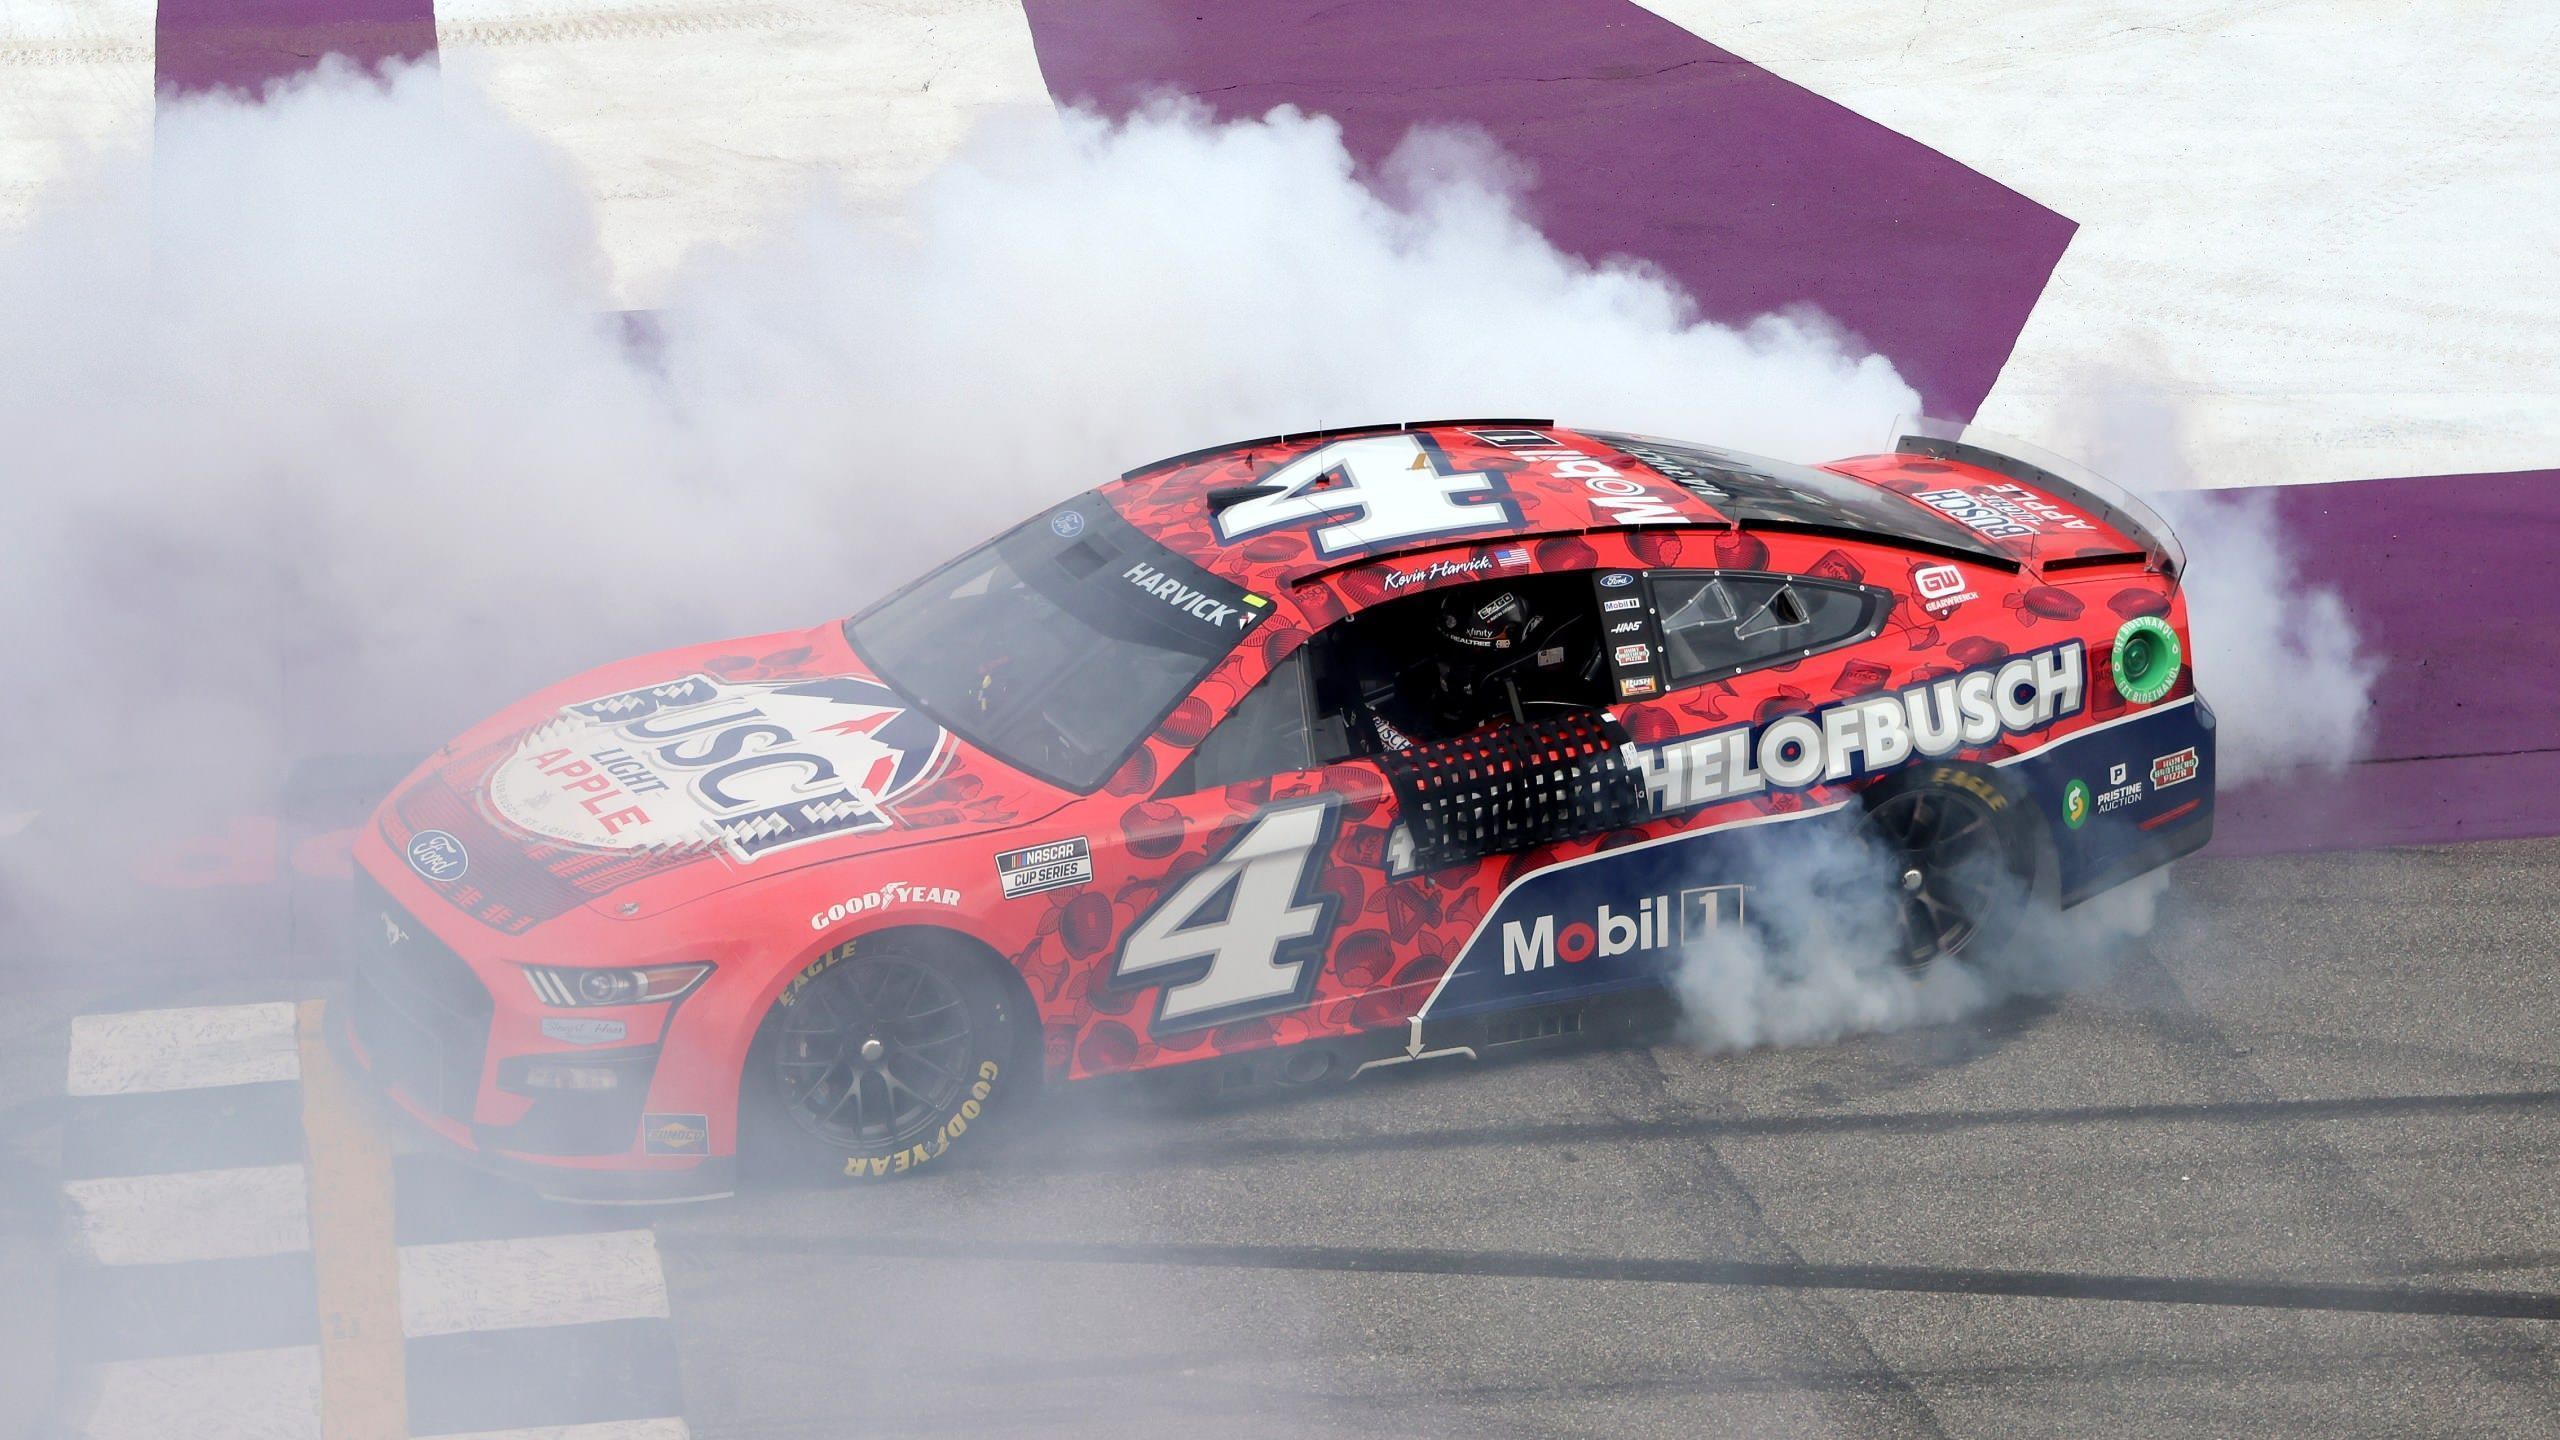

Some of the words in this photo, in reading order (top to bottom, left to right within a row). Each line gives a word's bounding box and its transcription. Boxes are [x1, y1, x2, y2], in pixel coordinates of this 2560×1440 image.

[1215, 432, 1511, 555] 4
[1508, 449, 1692, 525] Mobil
[1988, 483, 2098, 531] APPLE
[1914, 489, 2034, 538] BUSCH
[1975, 493, 2042, 525] LIGHT
[1384, 568, 1427, 591] Kevin
[1428, 555, 1491, 580] Harvick
[1606, 575, 1629, 586] Ford
[1122, 561, 1239, 627] HARVICK
[1605, 600, 1628, 611] Mobil
[1925, 591, 1979, 612] GEARWRENCH
[1450, 634, 1492, 647] REALTREE
[1466, 627, 1494, 638] xfinity
[1610, 621, 1642, 634] HAAS
[525, 747, 652, 836] APPLE
[590, 747, 670, 797] LIGHT
[2097, 782, 2143, 806] PRISTINE
[2098, 792, 2143, 814] AUCTION
[413, 835, 459, 876] Ford
[1014, 870, 1037, 887] CUP
[1038, 862, 1078, 882] SERIES
[1025, 843, 1074, 865] NASCAR
[810, 880, 961, 930] GOODYEAR
[1114, 801, 1328, 1021] 4
[1502, 895, 1669, 976] Mobil
[778, 939, 857, 1007] EAGLE
[843, 1060, 999, 1177] GOODYEAR
